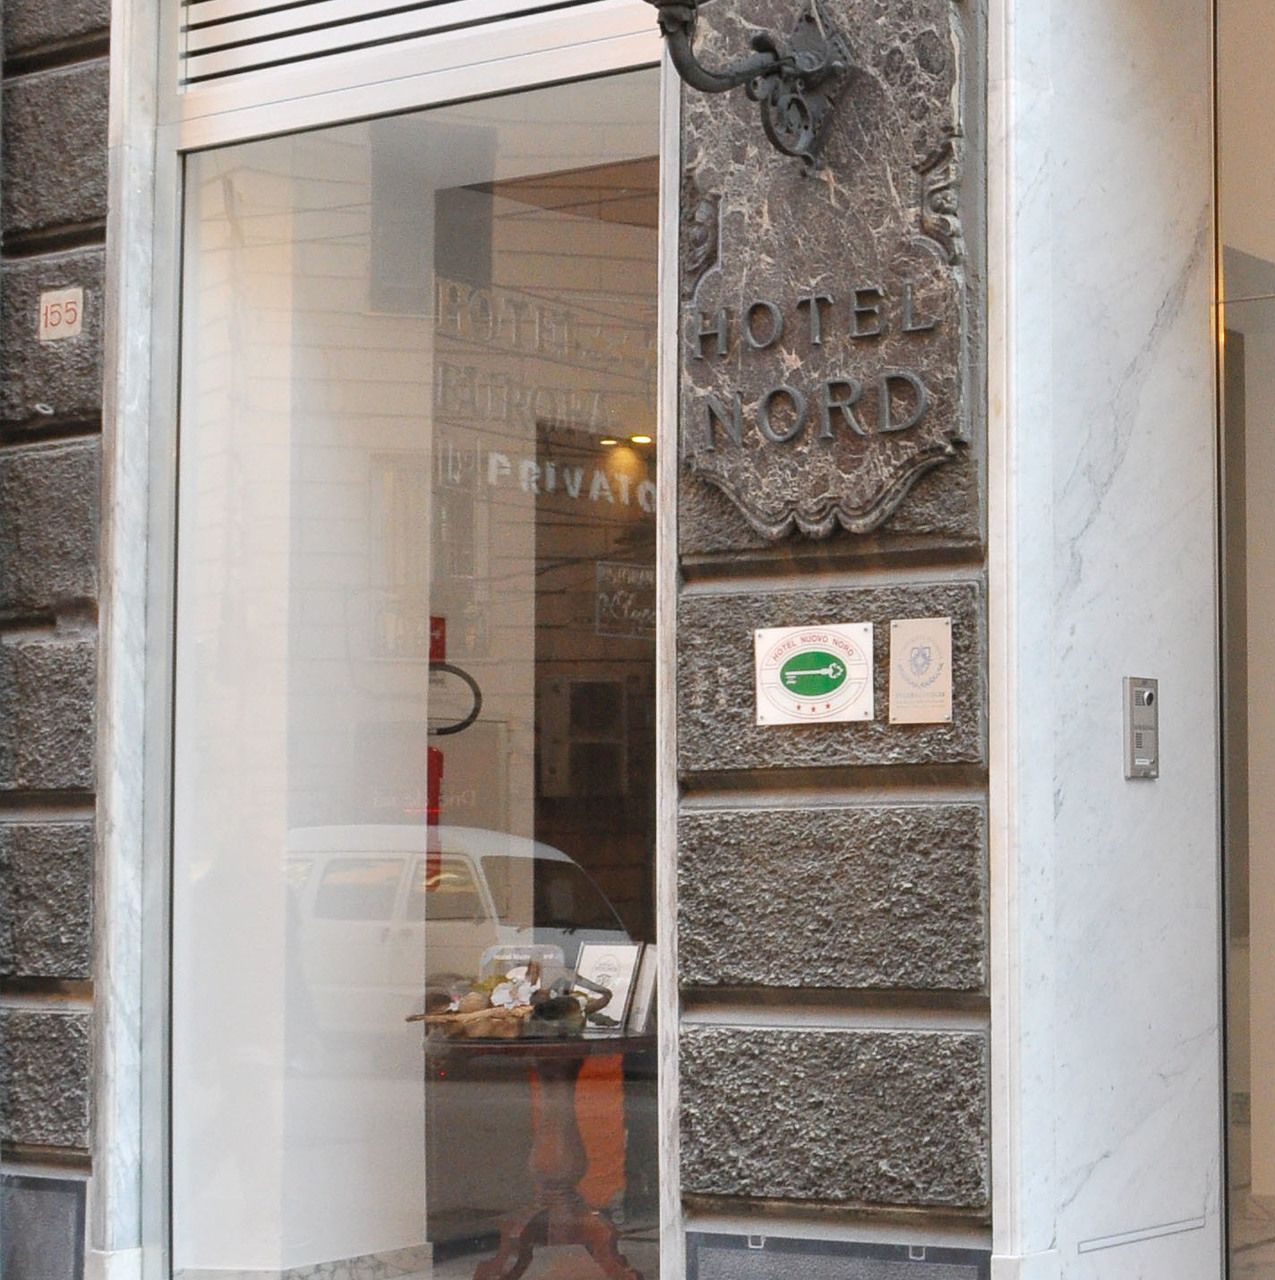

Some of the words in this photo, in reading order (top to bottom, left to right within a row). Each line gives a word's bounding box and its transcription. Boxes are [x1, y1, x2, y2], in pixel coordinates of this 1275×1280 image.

[42, 300, 78, 329] 155
[690, 284, 939, 360] HOTEL
[703, 371, 931, 453] NORD
[772, 640, 798, 661] HOTEL
[800, 634, 829, 644] NUOVO
[832, 638, 855, 657] NORD
